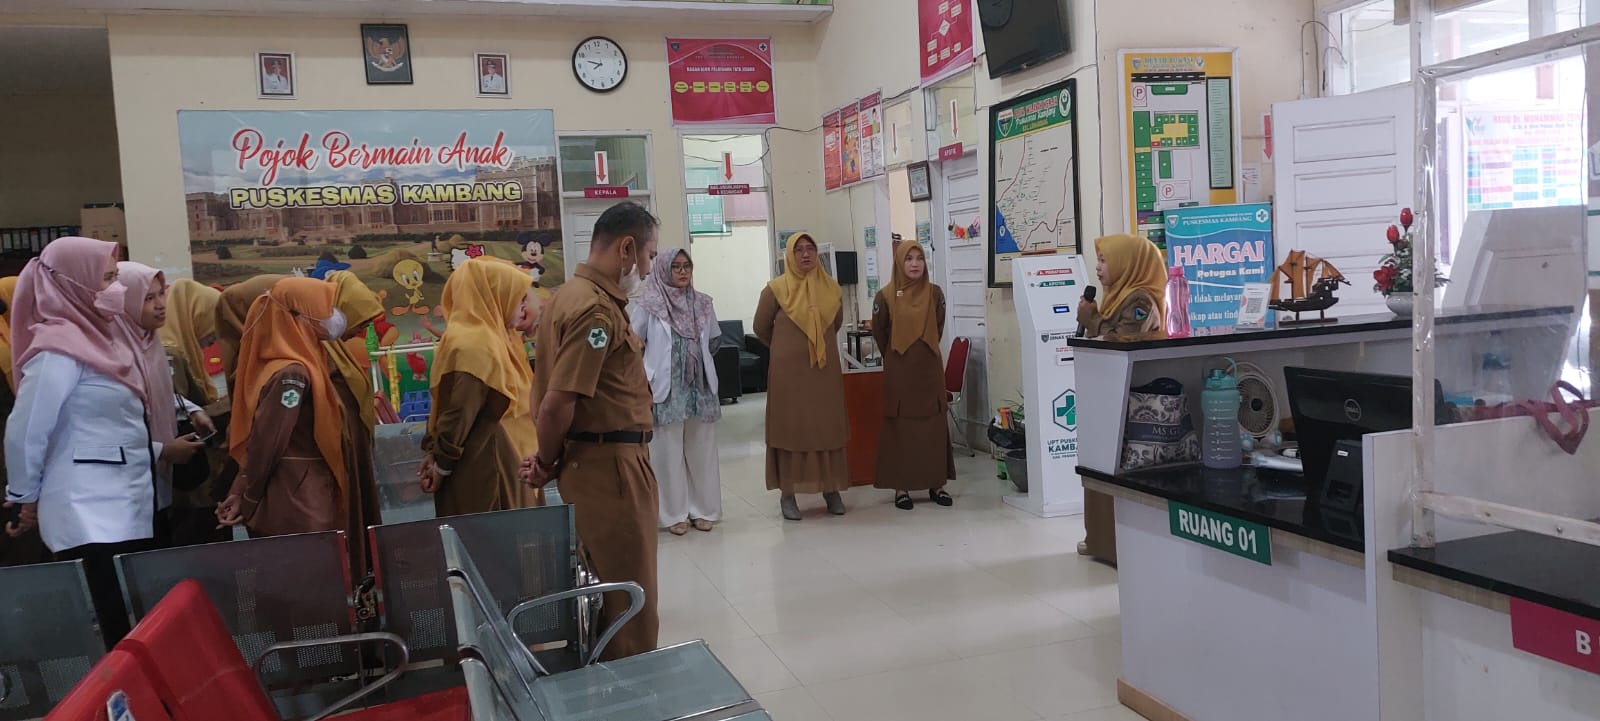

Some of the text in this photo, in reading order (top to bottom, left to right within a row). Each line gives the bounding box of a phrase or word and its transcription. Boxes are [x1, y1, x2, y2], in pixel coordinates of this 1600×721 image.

[1136, 88, 1143, 97] P
[232, 128, 512, 186] Pojok Bermain Anak
[231, 181, 523, 209] PUSKESMAS KAMBANG
[1165, 187, 1172, 196] P
[1183, 217, 1219, 225] PUSKESMAS
[1220, 215, 1253, 223] KAMBANG
[1173, 240, 1265, 267] HARGAI
[1197, 266, 1265, 278] Petugas Kami
[1194, 294, 1212, 304] tidak
[1214, 292, 1242, 303] melayan
[1190, 309, 1239, 322] ikap atau tind
[1048, 444, 1077, 453] KAMB
[1178, 508, 1257, 554] RUANG 01
